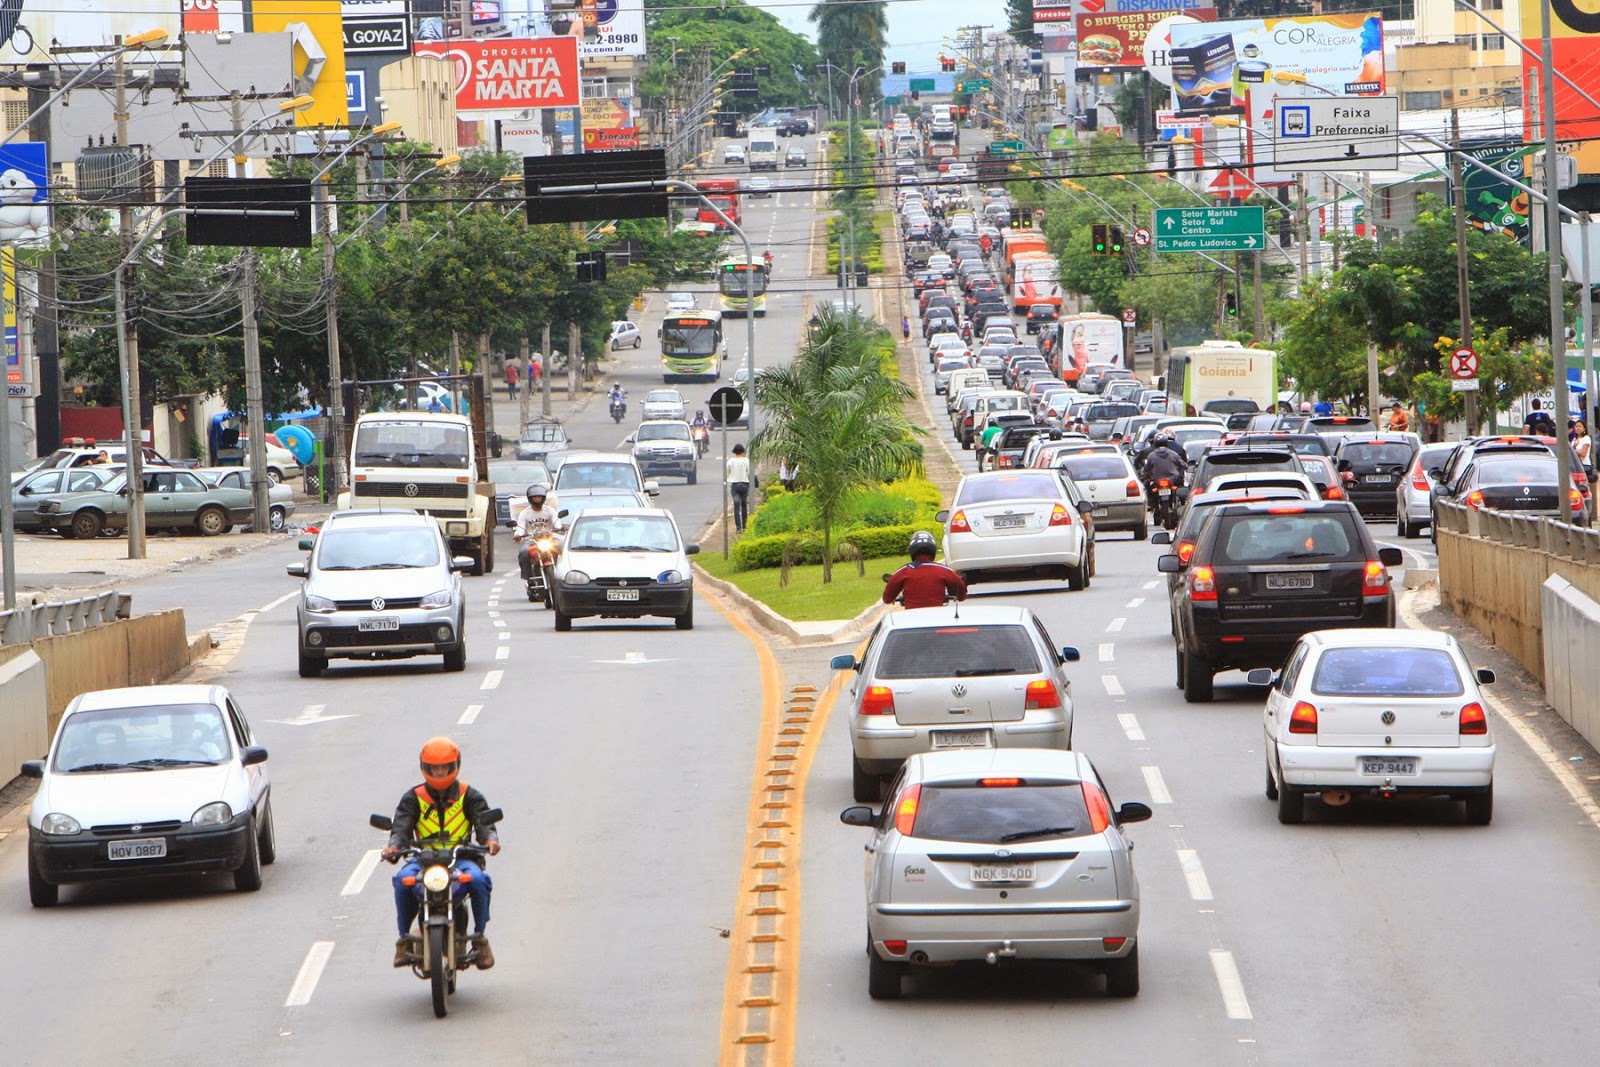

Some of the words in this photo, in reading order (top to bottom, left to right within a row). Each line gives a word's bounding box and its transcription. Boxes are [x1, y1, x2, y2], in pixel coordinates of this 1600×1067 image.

[1095, 14, 1145, 26] BURGER
[353, 29, 402, 43] GOYAZ
[1274, 27, 1316, 45] COR
[1316, 36, 1357, 46] ALEGRIA
[482, 47, 553, 57] DROGARIA
[475, 57, 561, 79] SANTA
[475, 79, 564, 100] MARTA
[1333, 107, 1370, 118] Faixa
[1315, 124, 1389, 136] Preferencial
[1181, 210, 1204, 218] Setor
[1207, 209, 1238, 217] Marista
[1181, 218, 1206, 226] Setor
[1209, 217, 1224, 226] Sul
[1181, 226, 1212, 235] Centro
[1158, 240, 1169, 248] St.
[1172, 239, 1197, 247] Pedro
[1199, 238, 1238, 247] Ludovico
[1199, 365, 1247, 377] Goiânia
[7, 383, 26, 395] rich
